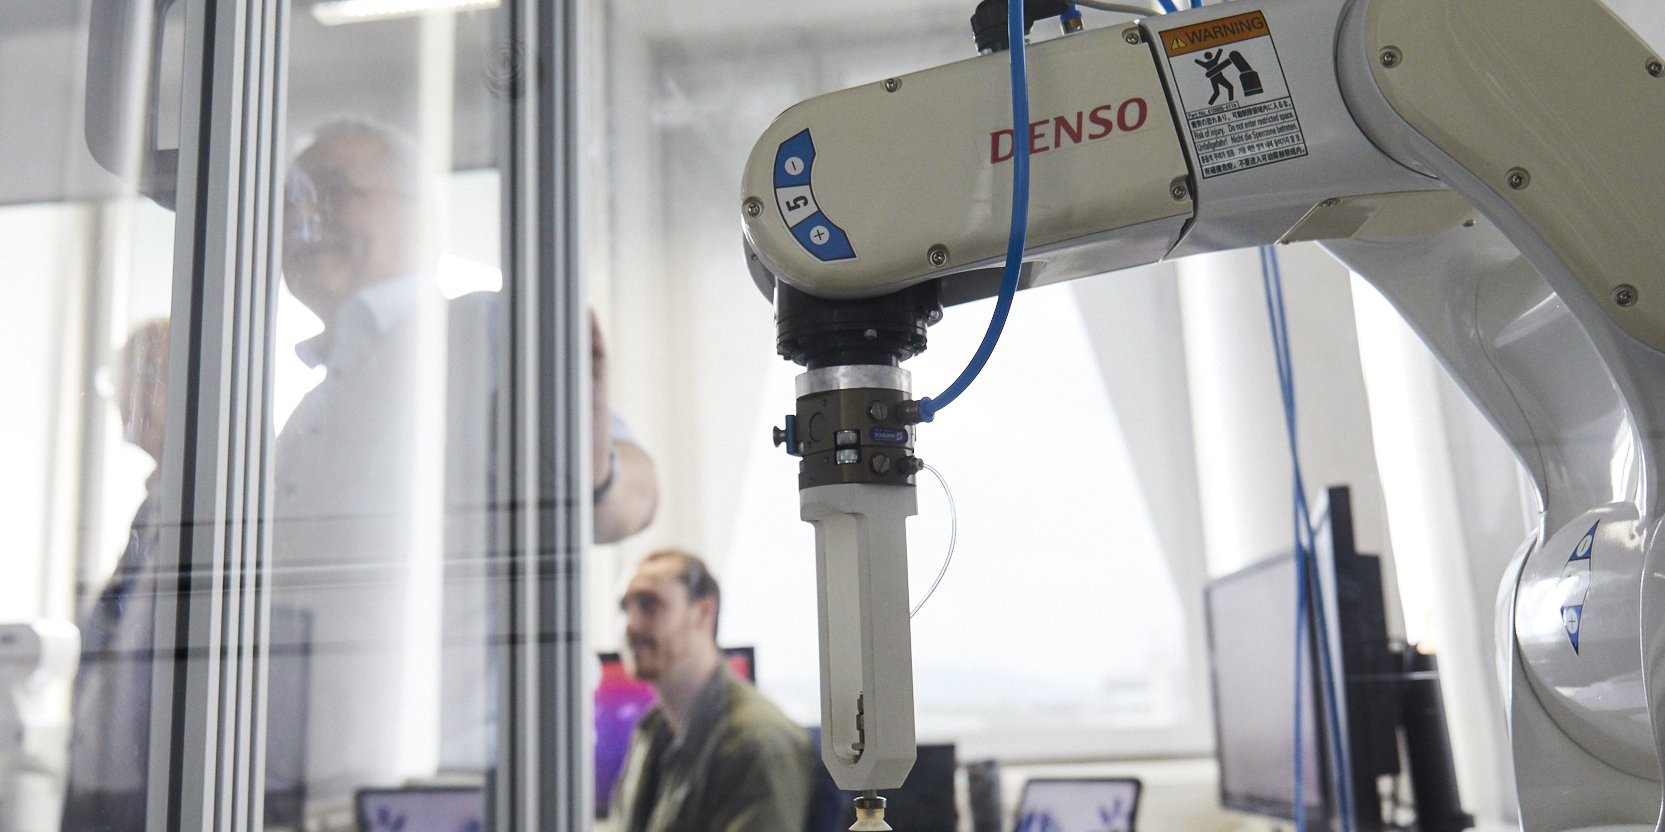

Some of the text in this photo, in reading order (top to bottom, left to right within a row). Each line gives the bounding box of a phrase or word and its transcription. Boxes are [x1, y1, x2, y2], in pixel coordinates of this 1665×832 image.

[1186, 16, 1264, 44] WARNING
[990, 97, 1148, 164] DENSO
[1194, 131, 1204, 139] Risk
[1204, 129, 1210, 137] of
[1228, 123, 1235, 131] Do
[1244, 120, 1256, 128] enter
[1257, 114, 1279, 125] restricted
[1231, 134, 1244, 143] Nicht
[1244, 132, 1252, 140] die
[1252, 126, 1276, 139] Sperrzone
[786, 195, 809, 212] 5
